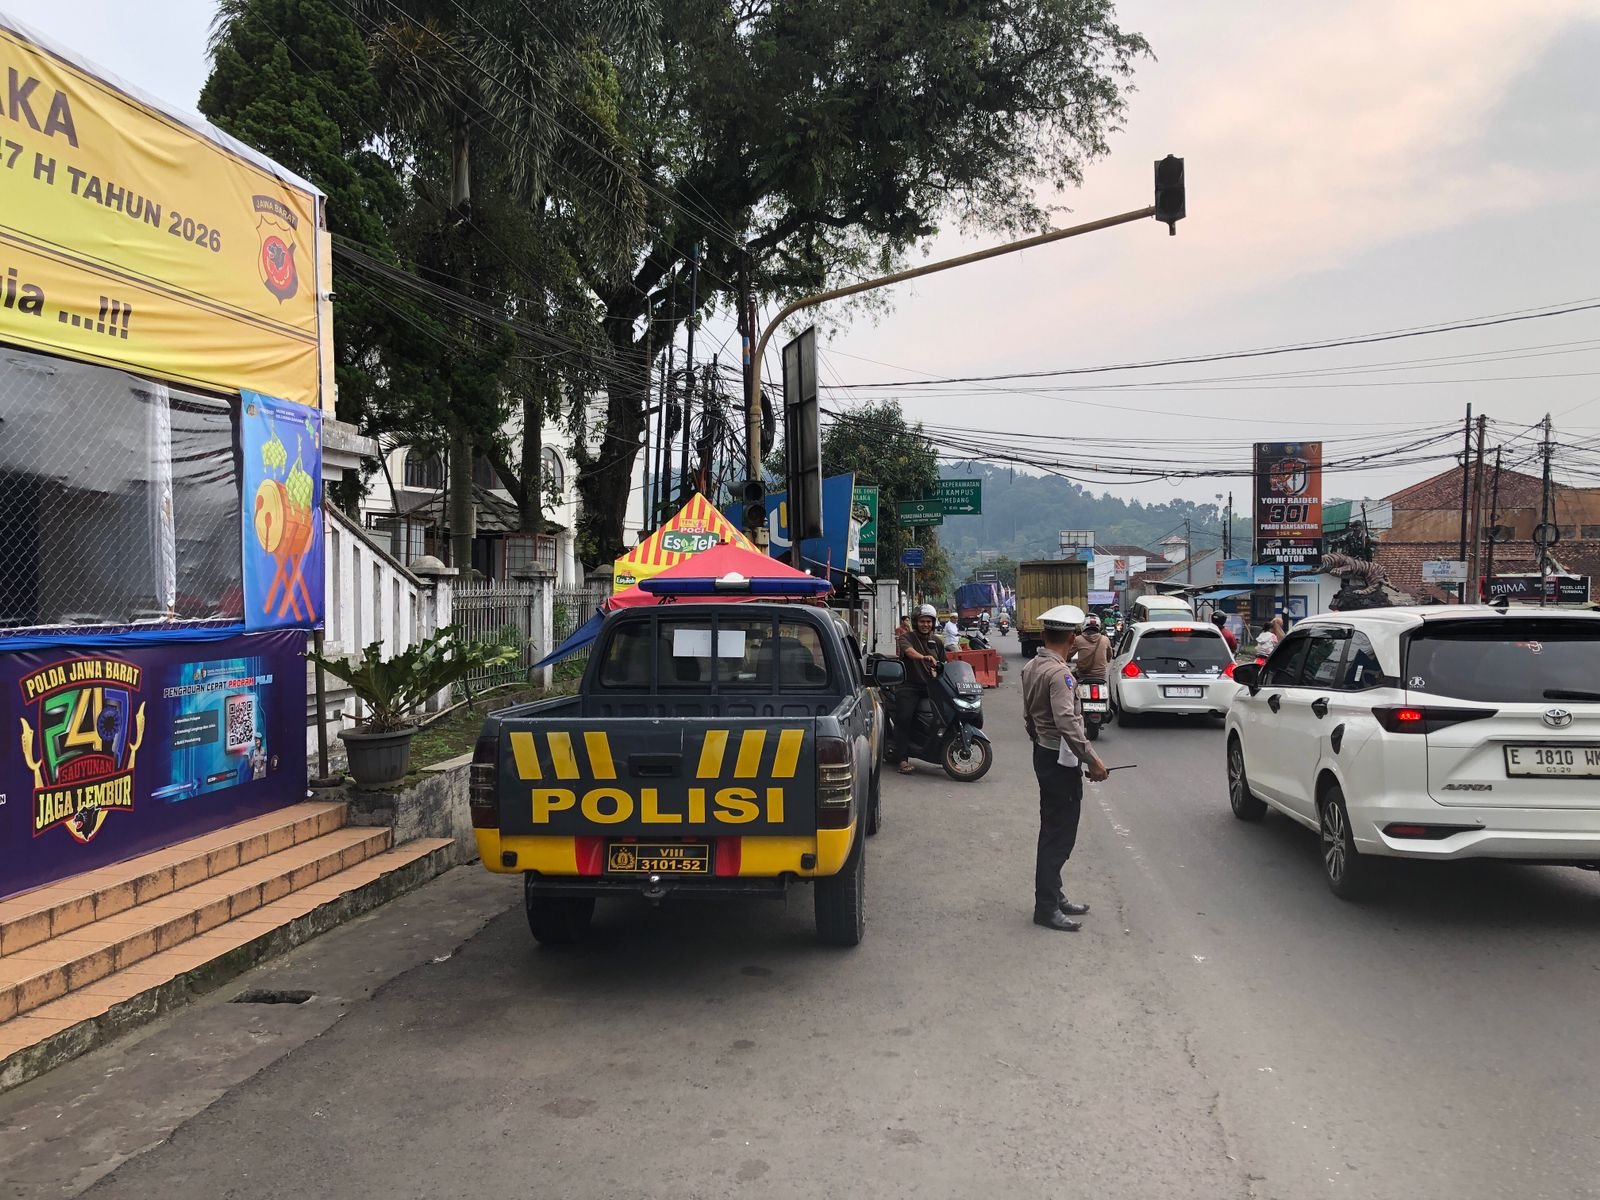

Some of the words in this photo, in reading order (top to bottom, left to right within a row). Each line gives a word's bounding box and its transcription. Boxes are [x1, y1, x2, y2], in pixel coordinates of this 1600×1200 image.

[0, 66, 79, 148] KA
[0, 136, 24, 170] 7
[33, 152, 56, 185] H
[67, 165, 161, 228] TAHUN
[168, 211, 221, 253] 2026
[256, 199, 274, 211] JAWA
[274, 204, 296, 224] BARAT
[0, 267, 45, 317] ia
[1269, 504, 1309, 523] 301
[663, 535, 681, 550] Es
[691, 535, 717, 550] Teh
[1282, 547, 1317, 555] PERKASA
[1490, 583, 1526, 595] PRIMA
[26, 666, 66, 699] POLDA
[69, 661, 102, 682] JAWA
[105, 661, 140, 686] BARAT
[206, 681, 227, 691] CEPAT
[1510, 749, 1520, 765] E
[1535, 749, 1574, 765] 1810
[61, 759, 112, 783] SAUYUNAN
[1441, 783, 1492, 792] AVANZA
[36, 790, 74, 830] JAGA
[76, 775, 132, 810] LEMBUR
[531, 787, 784, 824] POLISI
[660, 848, 684, 857] VIII
[641, 860, 701, 870] 3101-52
